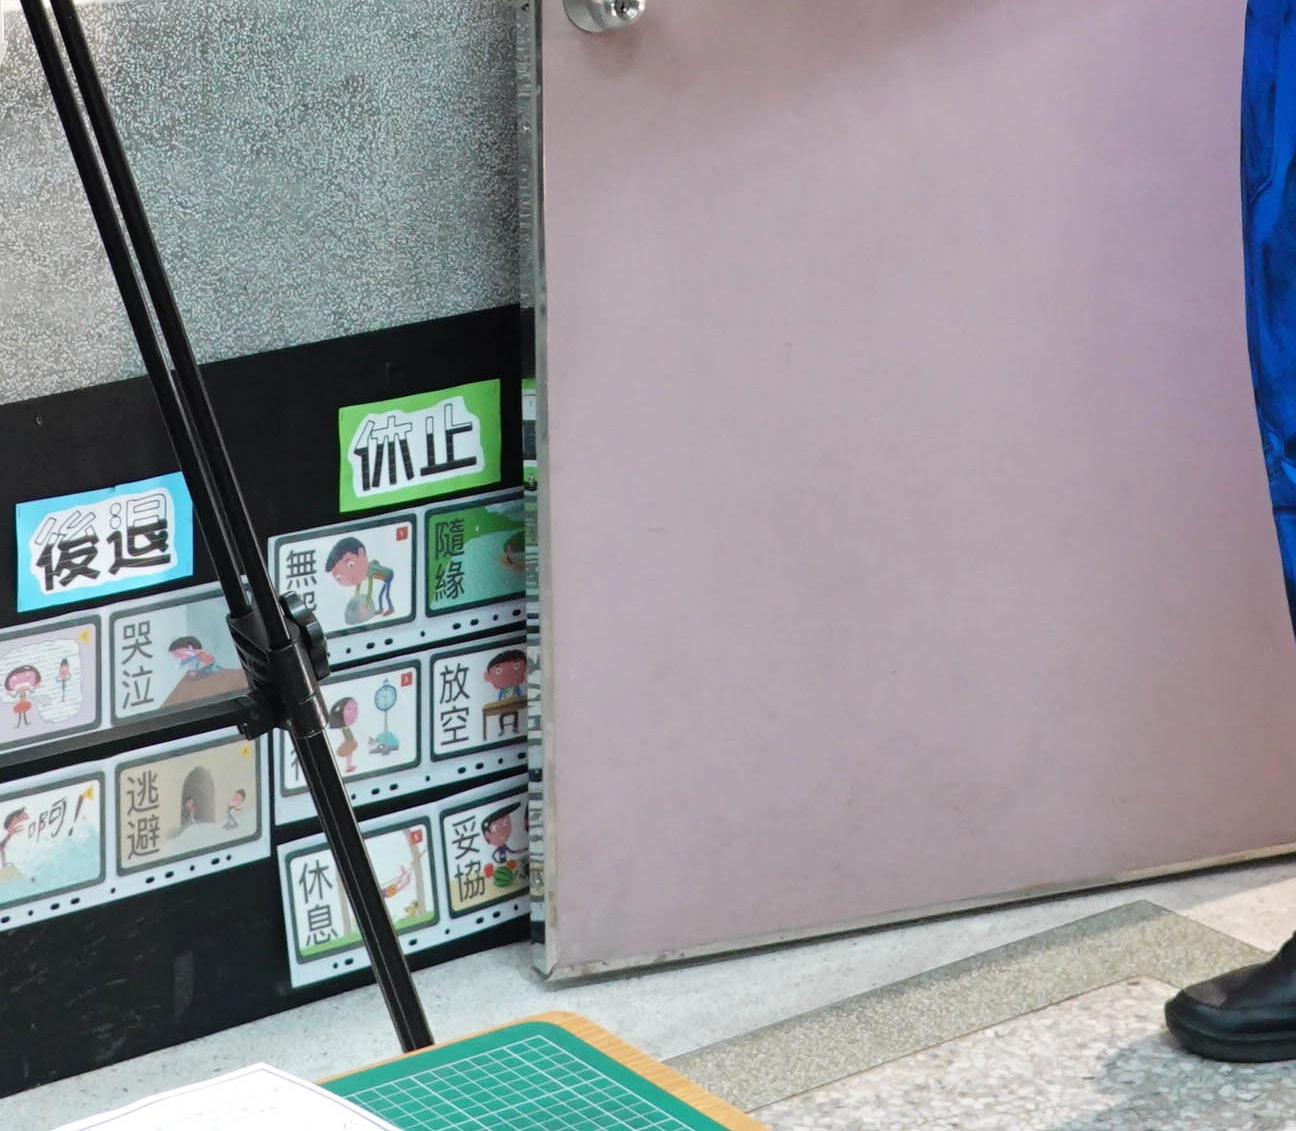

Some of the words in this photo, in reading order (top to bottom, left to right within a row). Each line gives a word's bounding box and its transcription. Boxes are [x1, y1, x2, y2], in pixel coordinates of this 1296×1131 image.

[354, 405, 478, 491] 休止
[34, 491, 172, 590] 後退
[434, 519, 466, 602] 隨緣
[120, 621, 156, 710] 哭泣
[439, 663, 470, 746] 放空
[125, 769, 160, 862] 逃避
[452, 815, 485, 902] 妥協
[299, 860, 338, 946] 休息
